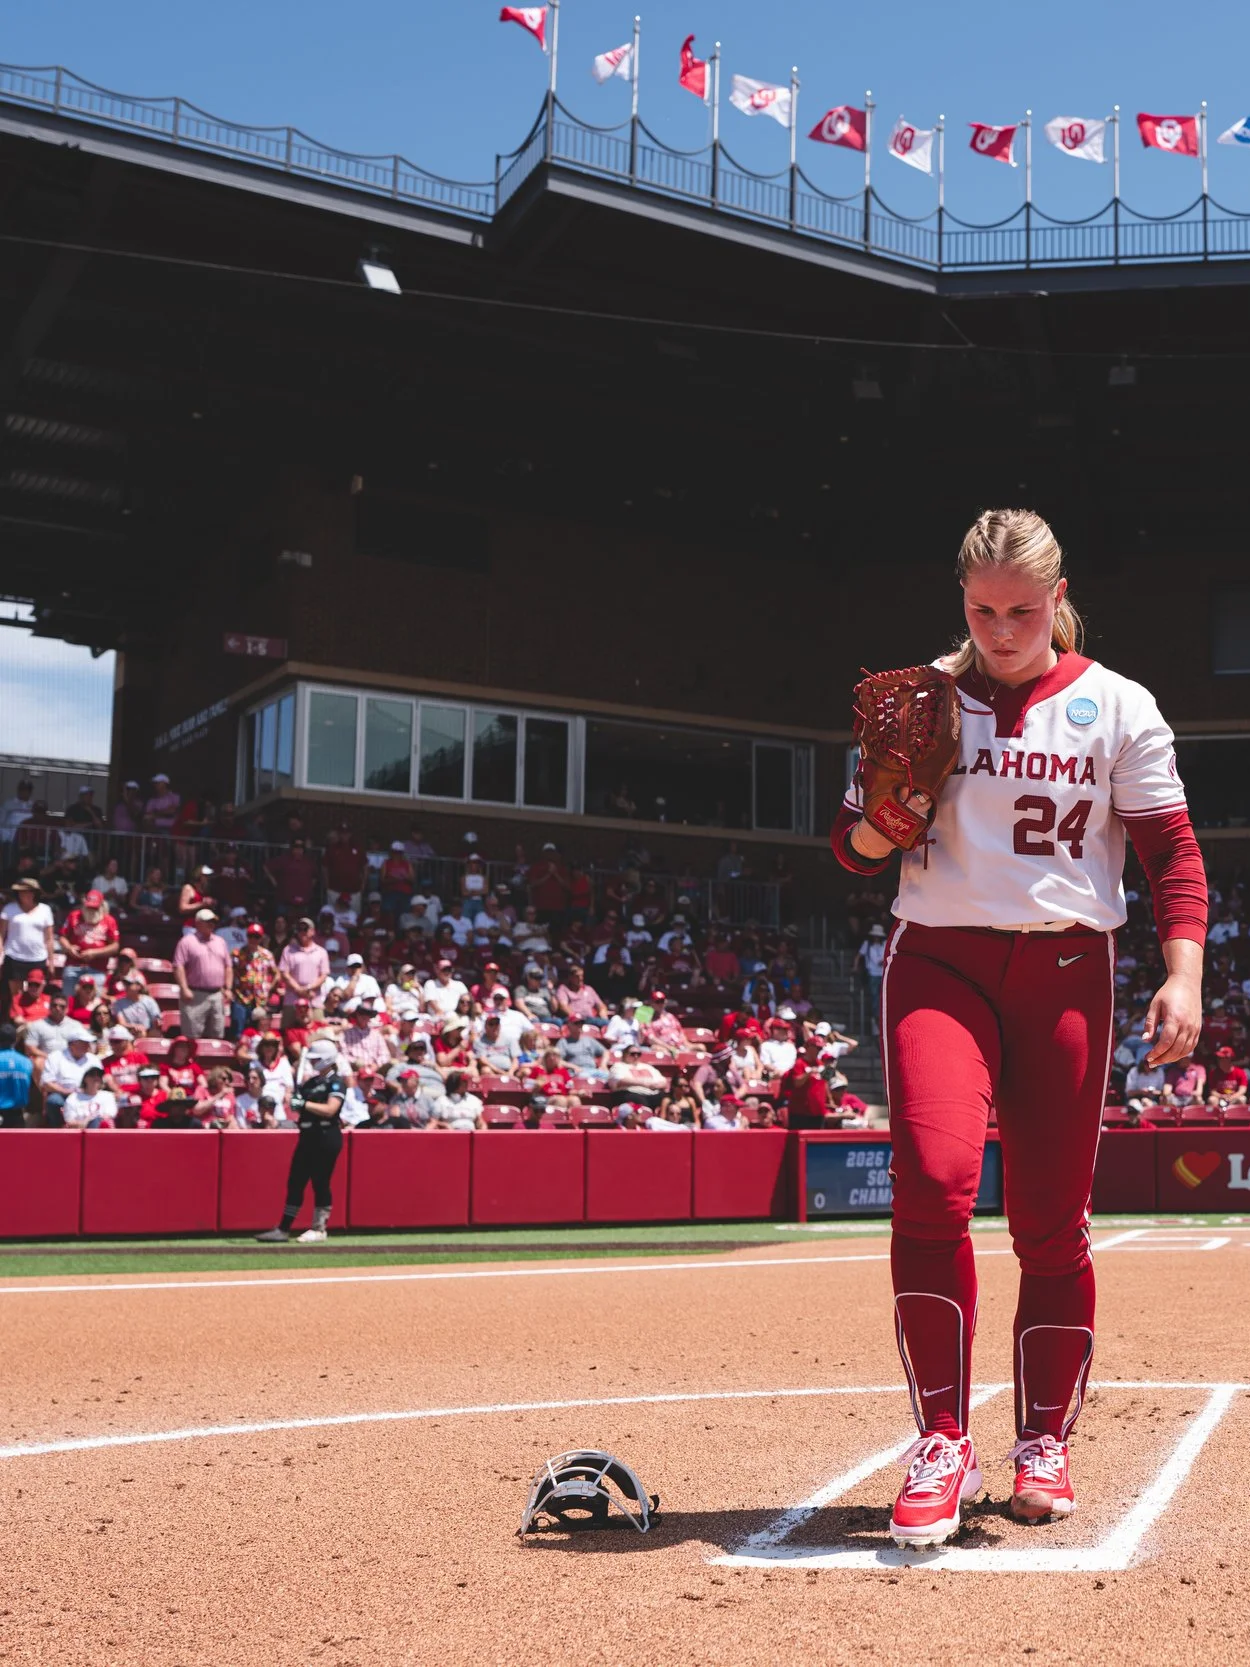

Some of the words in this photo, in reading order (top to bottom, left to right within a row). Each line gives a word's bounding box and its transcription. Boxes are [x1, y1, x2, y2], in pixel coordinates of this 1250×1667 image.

[879, 808, 910, 831] Rawlings
[1013, 794, 1093, 859] 24
[846, 1151, 885, 1167] 2026
[814, 1192, 826, 1209] 0
